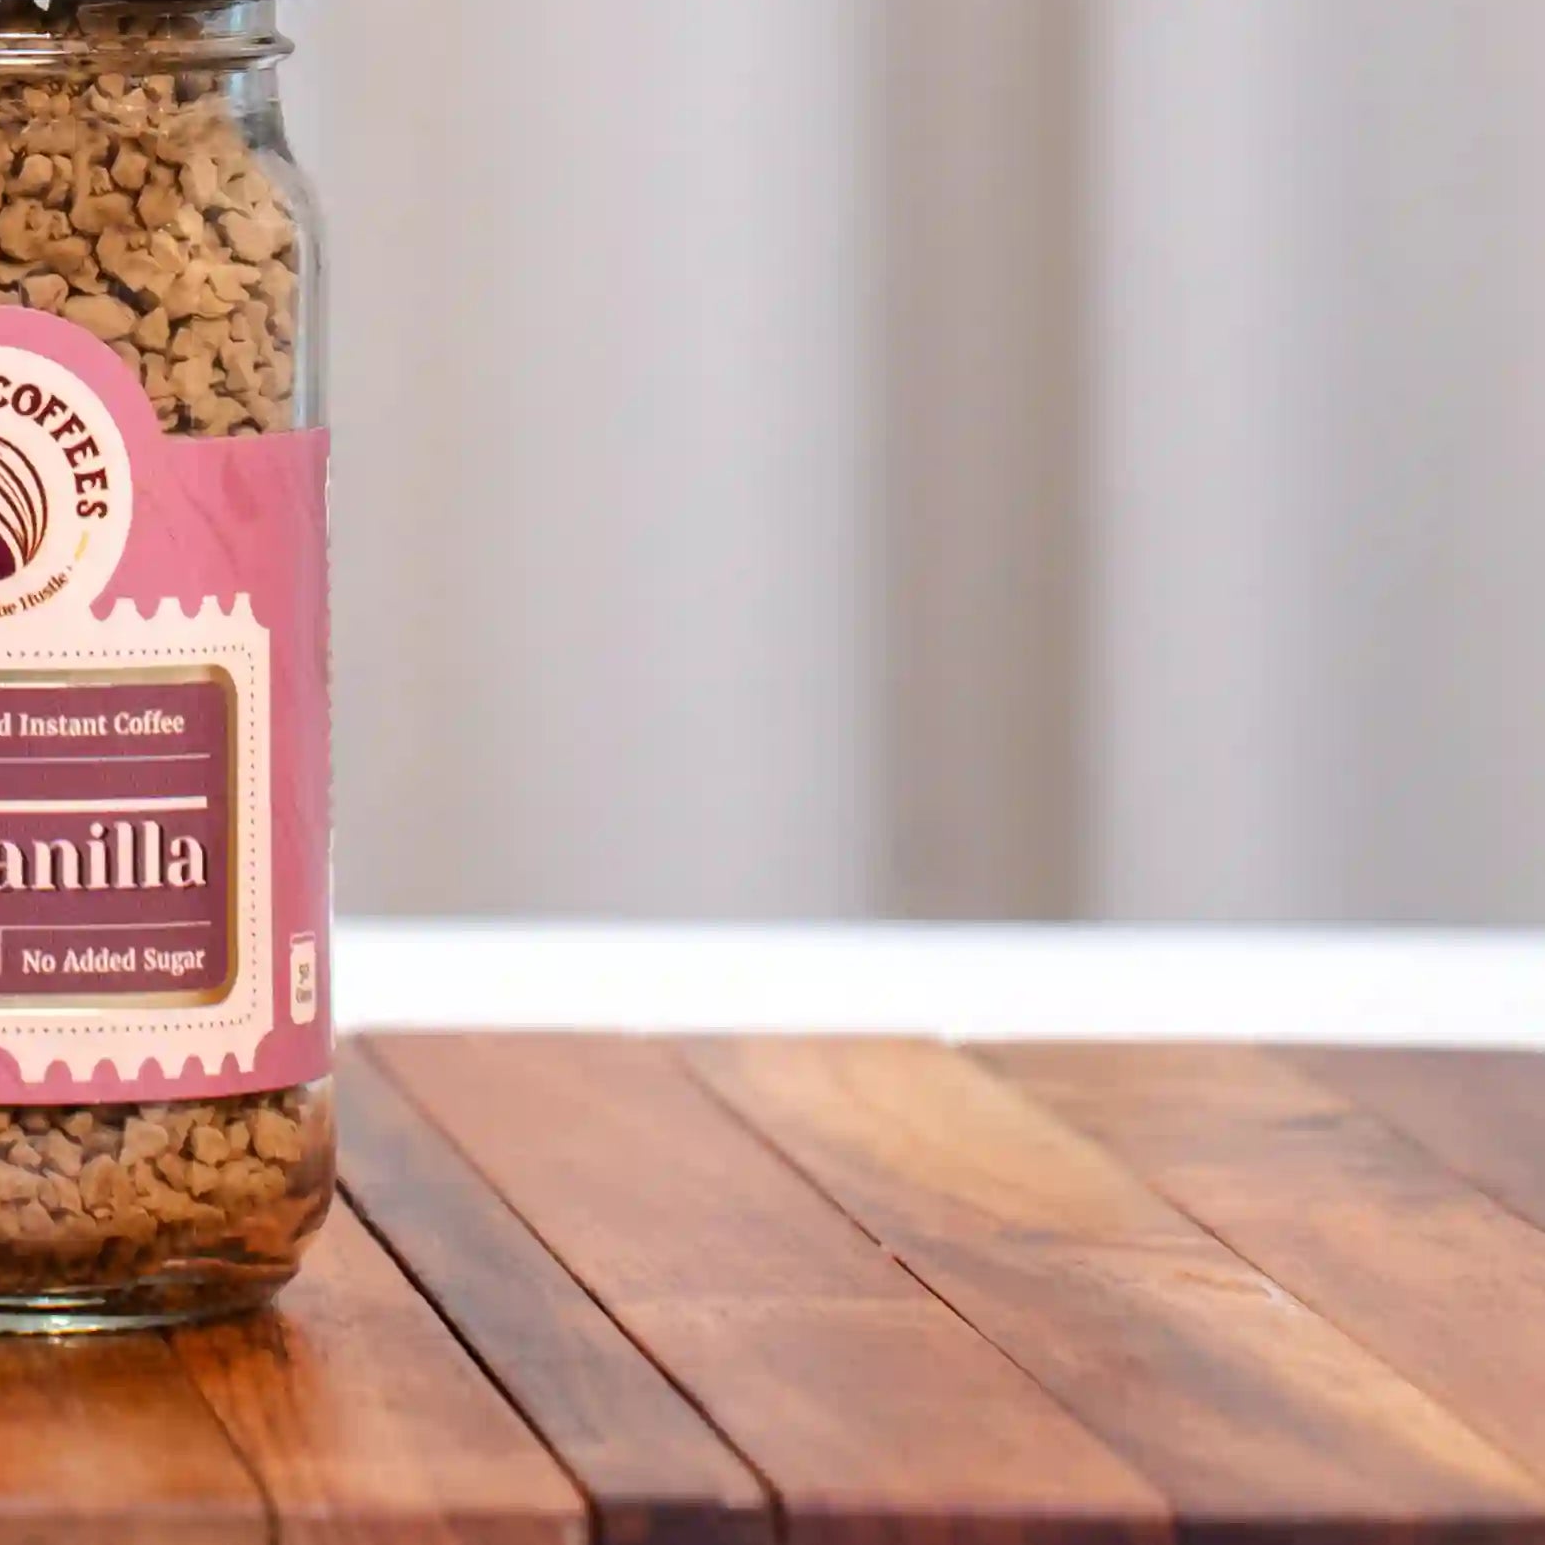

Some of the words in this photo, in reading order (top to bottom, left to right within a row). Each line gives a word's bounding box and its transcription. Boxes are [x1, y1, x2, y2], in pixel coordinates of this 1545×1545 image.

[19, 572, 68, 611] Hustle
[19, 712, 108, 737] Instant
[113, 708, 185, 735] Coffee
[21, 948, 57, 975] No
[62, 946, 136, 974] Added
[143, 946, 206, 977] Sugar
